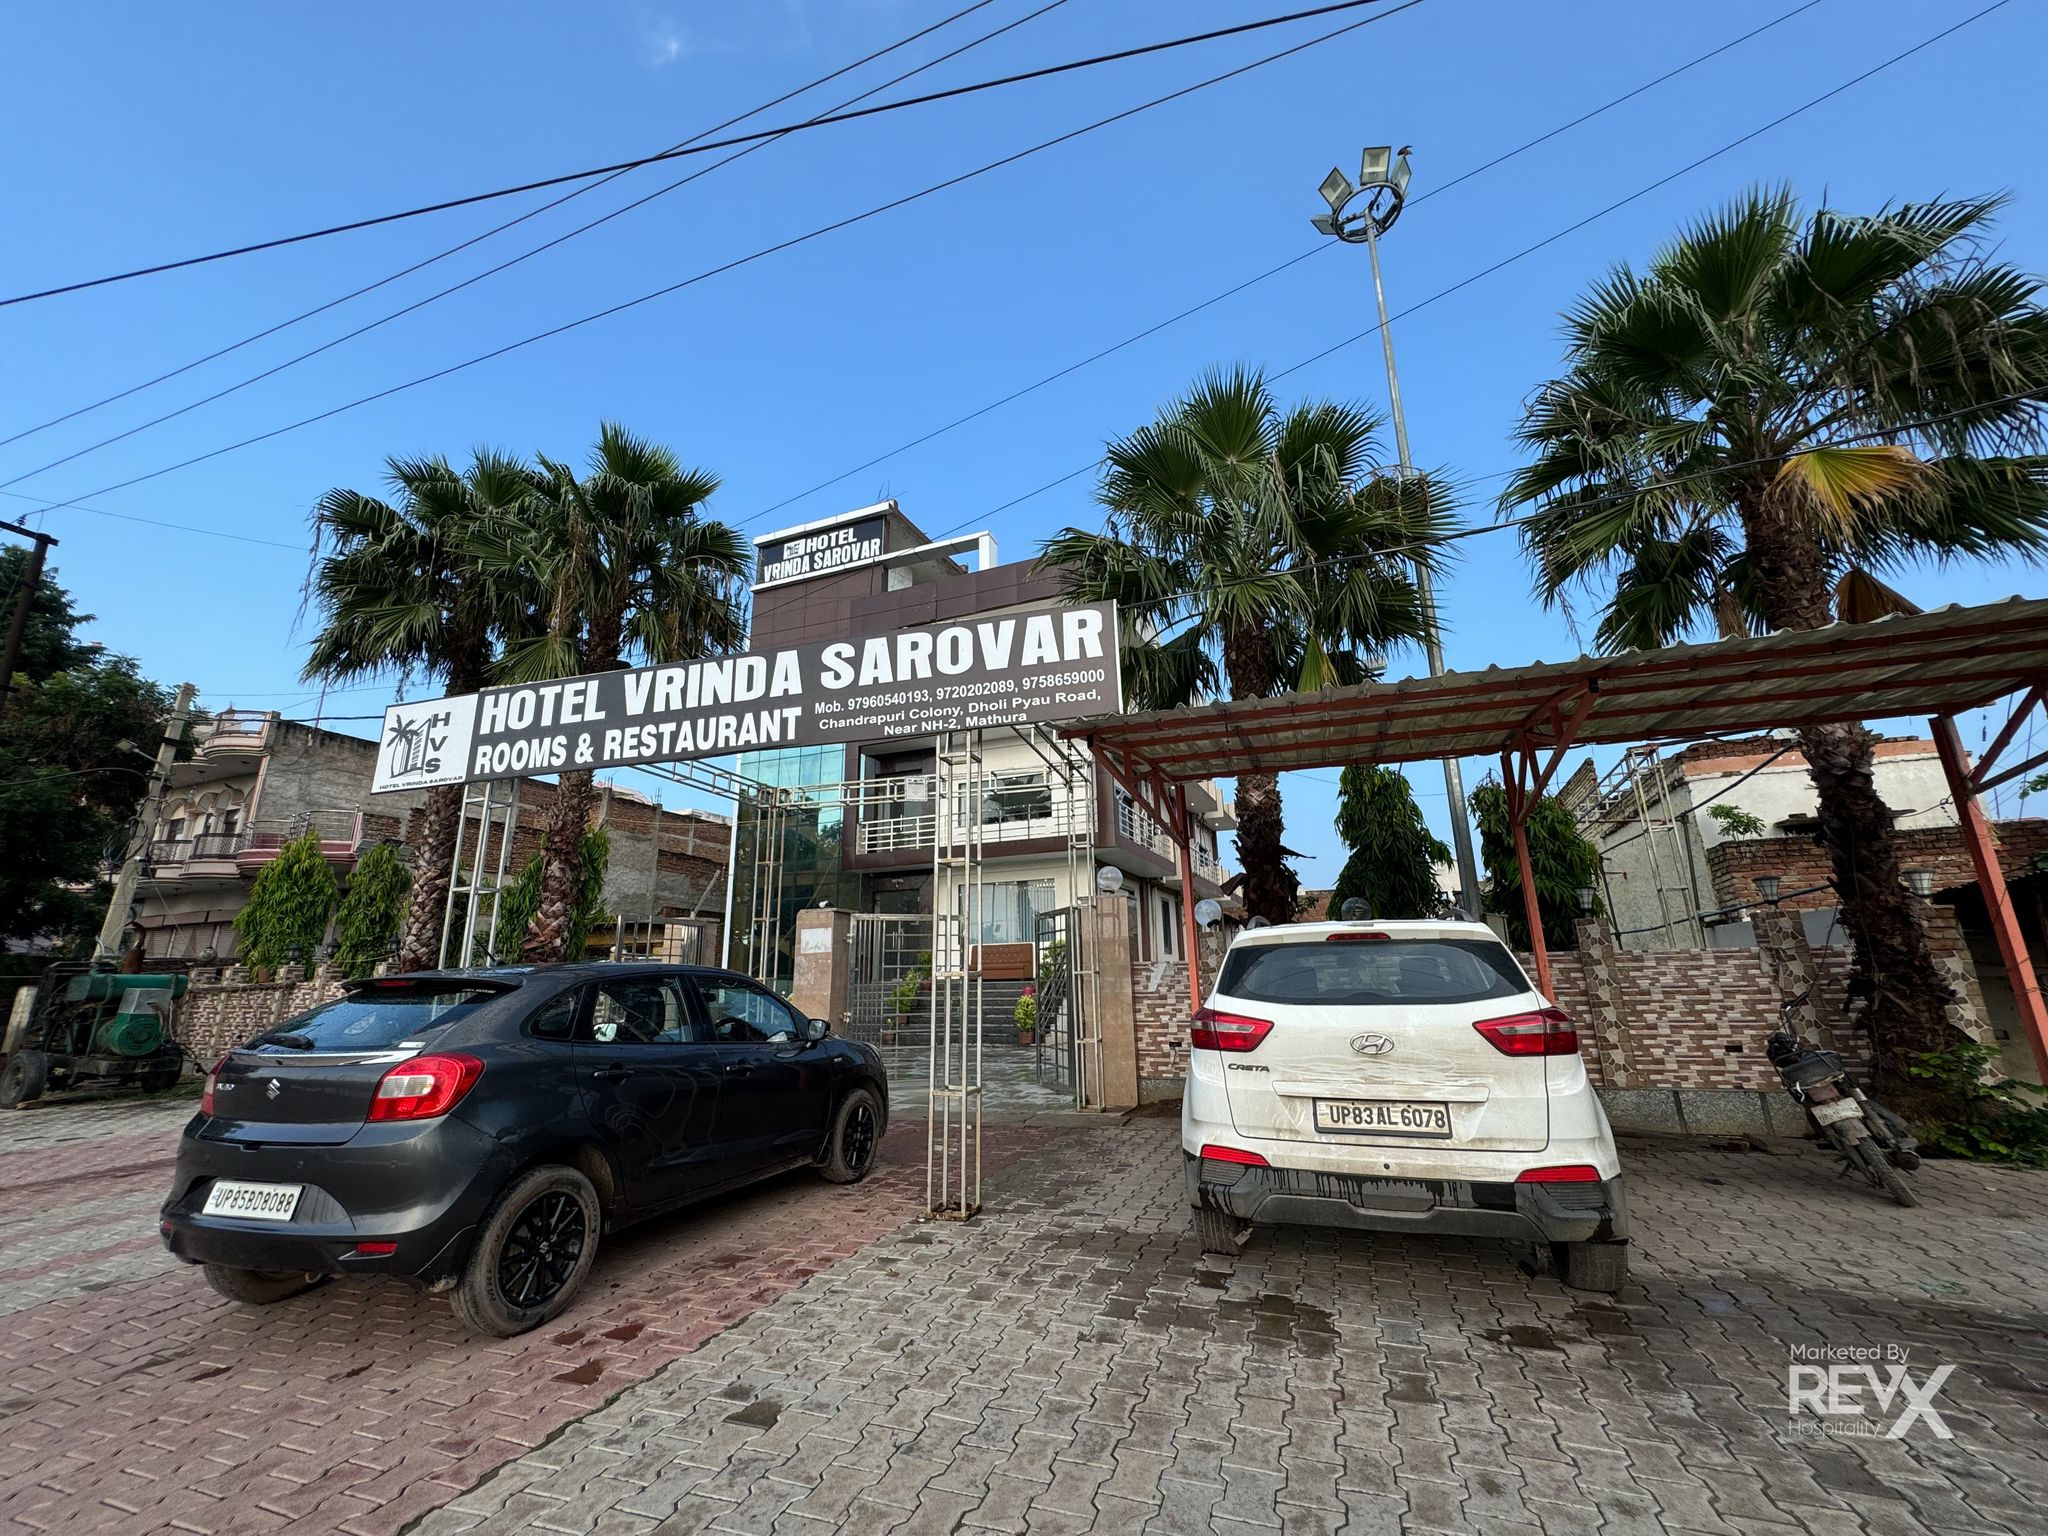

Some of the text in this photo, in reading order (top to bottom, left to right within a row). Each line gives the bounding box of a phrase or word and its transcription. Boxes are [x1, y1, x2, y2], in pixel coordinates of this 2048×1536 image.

[764, 556, 810, 583] VRINDA
[813, 538, 881, 570] SAROVAR
[806, 527, 857, 553] HOTEL
[479, 609, 1104, 735] HOTEL VRINDA SAROVAR
[815, 669, 1105, 715] Mob. 97960540193, 9720202089, 9758659000
[819, 689, 1101, 730] Chandrapuri Colony, Dholi Pyau Road,
[884, 712, 1027, 737] Near NH-2, Mathura
[474, 706, 803, 775] ROOMS & RESTAURANT
[380, 775, 463, 790] HOTEL VRINDA SAROVAR
[1228, 1063, 1270, 1072] CRETA
